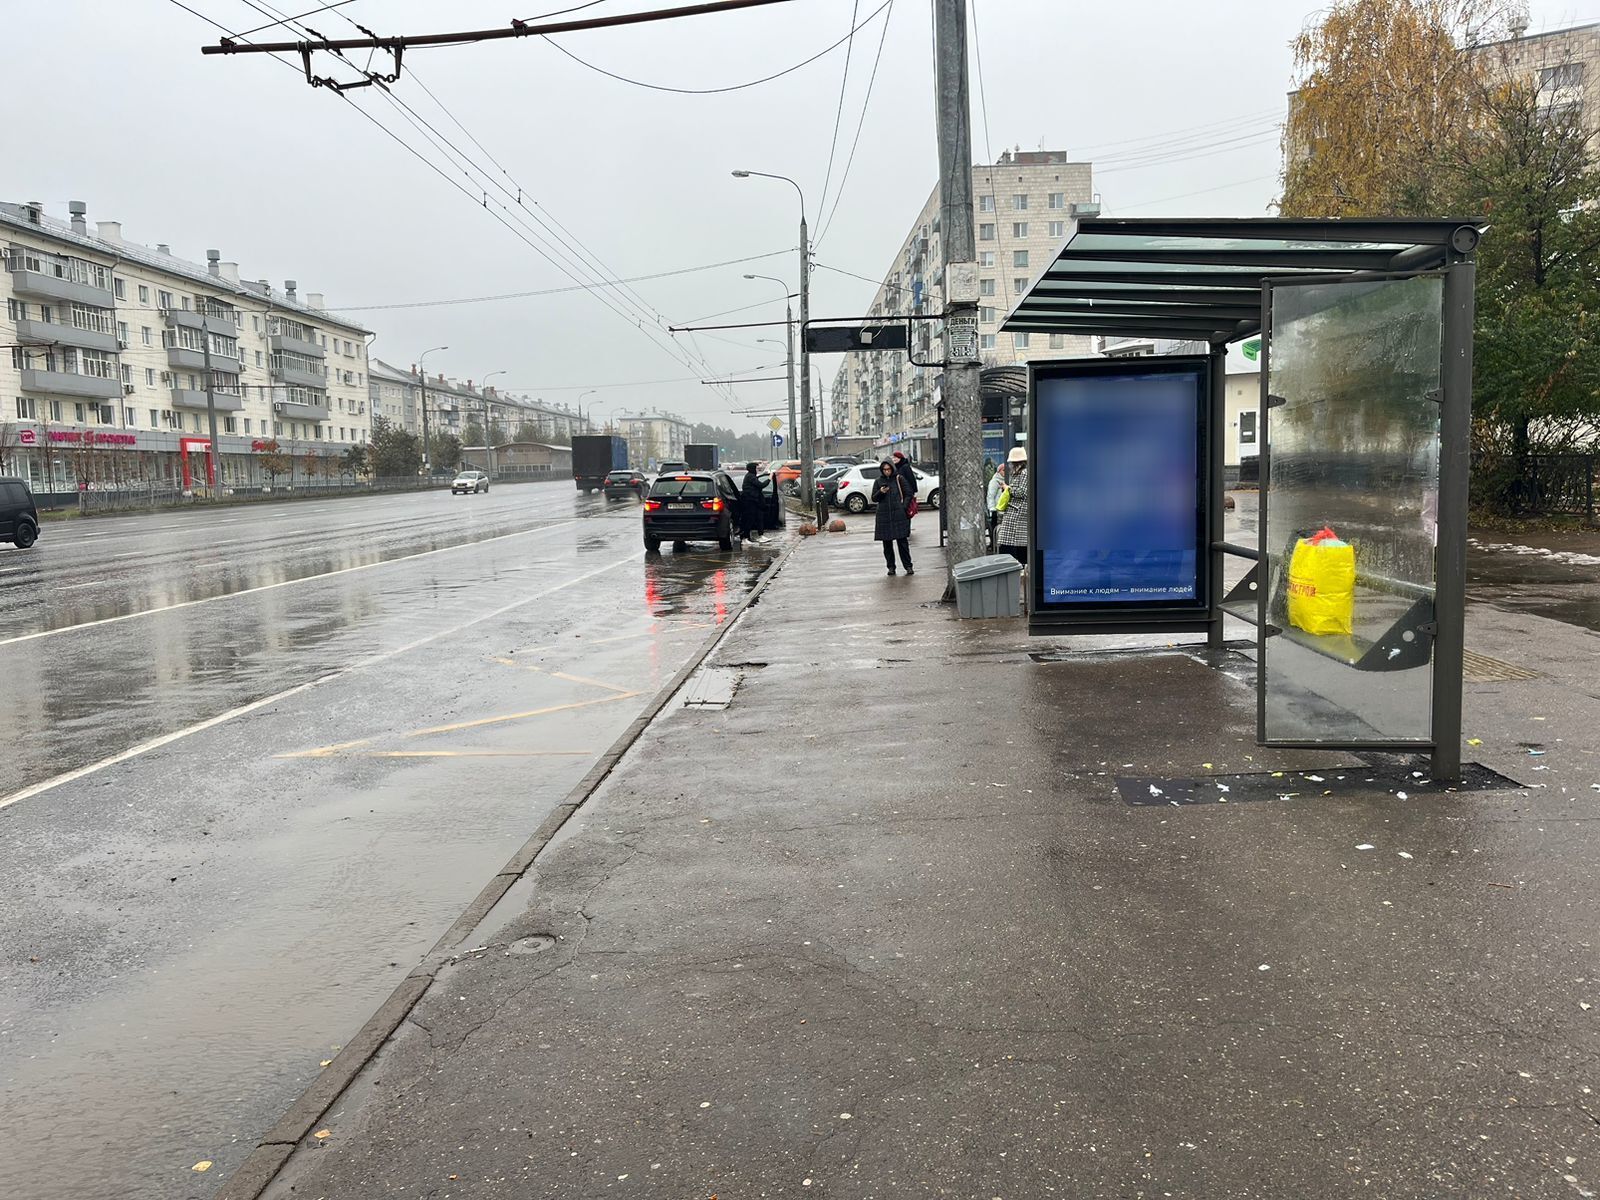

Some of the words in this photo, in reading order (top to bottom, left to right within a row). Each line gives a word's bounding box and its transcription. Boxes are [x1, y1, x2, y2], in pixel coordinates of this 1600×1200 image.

[951, 317, 975, 326] ДЕНЬГИ
[1050, 587, 1088, 596] Внимание
[1167, 585, 1193, 593] людей
